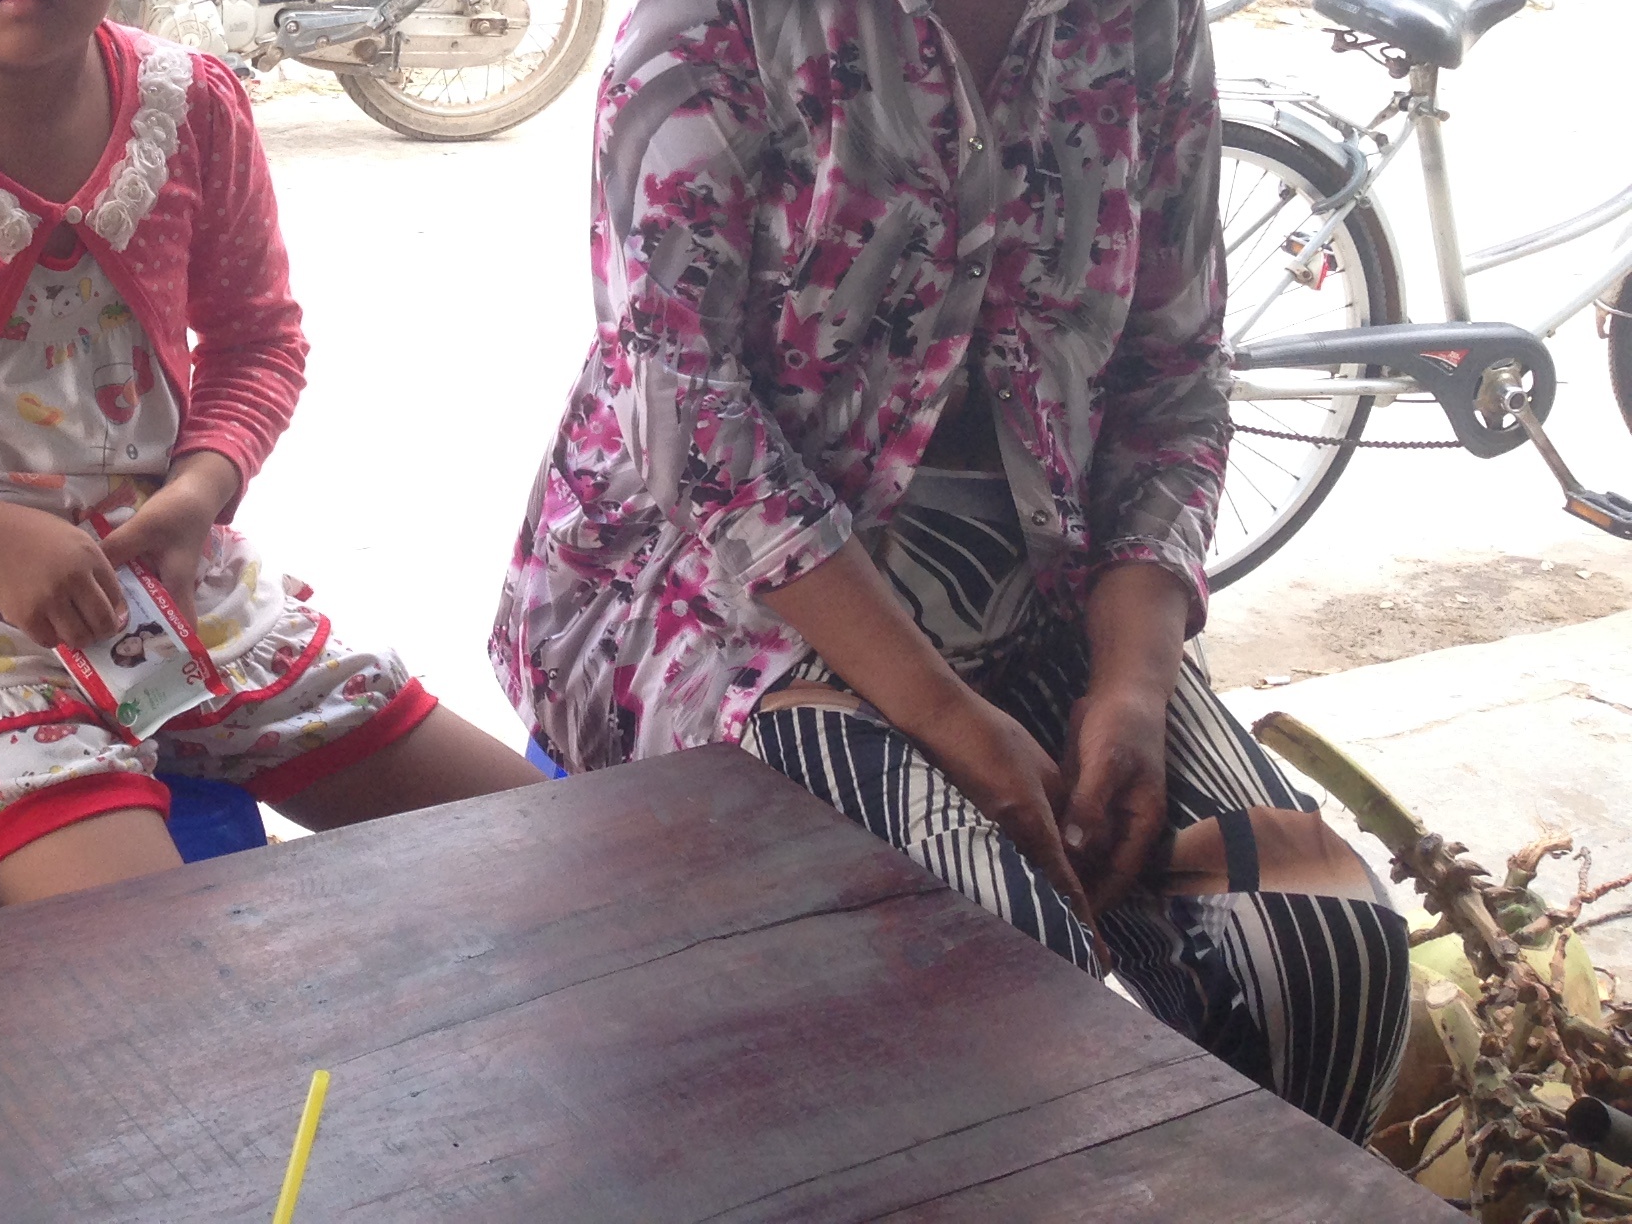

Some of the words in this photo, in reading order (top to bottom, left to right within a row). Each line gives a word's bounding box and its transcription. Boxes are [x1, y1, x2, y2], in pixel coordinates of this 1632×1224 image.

[156, 595, 170, 610] For
[71, 650, 94, 680] TEEN
[182, 661, 203, 685] 20
